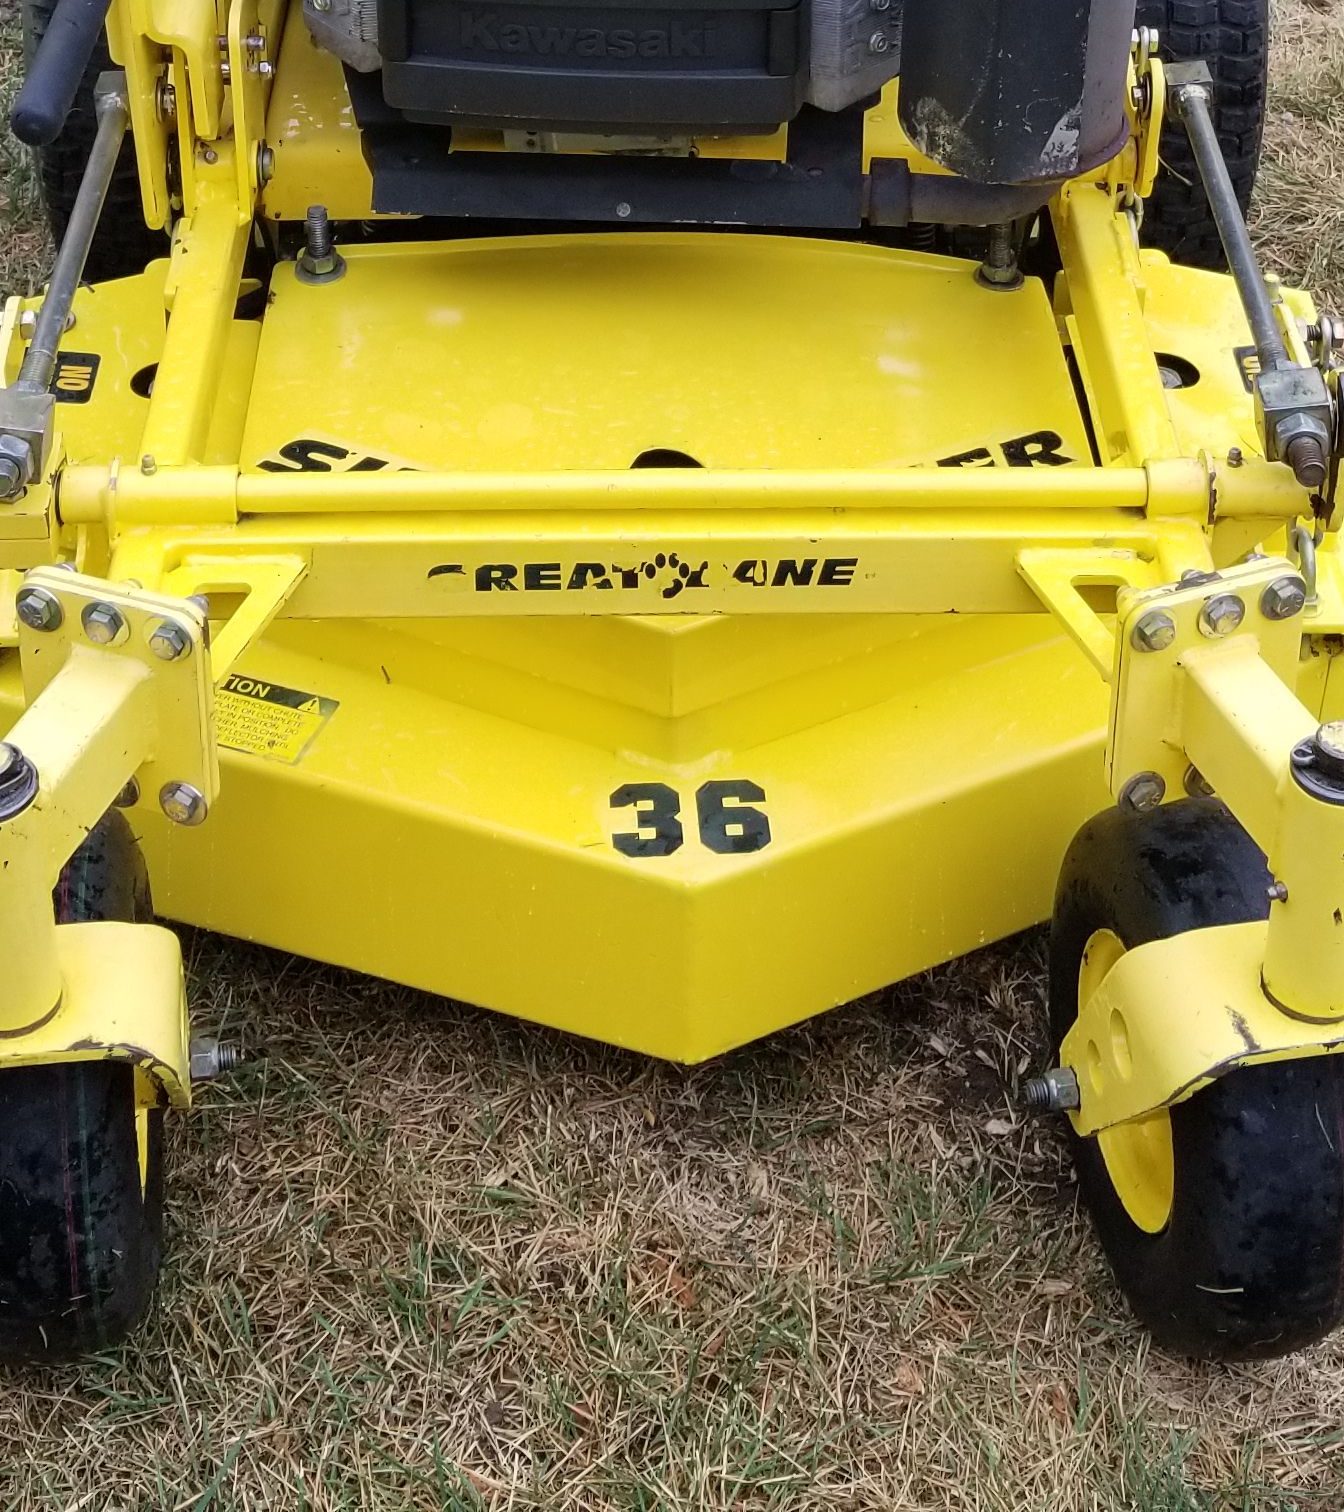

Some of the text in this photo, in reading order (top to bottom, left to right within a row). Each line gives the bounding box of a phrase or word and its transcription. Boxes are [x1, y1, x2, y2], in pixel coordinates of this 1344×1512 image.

[458, 11, 719, 59] Kawasaki
[223, 674, 271, 698] TION
[608, 777, 774, 860] 36
